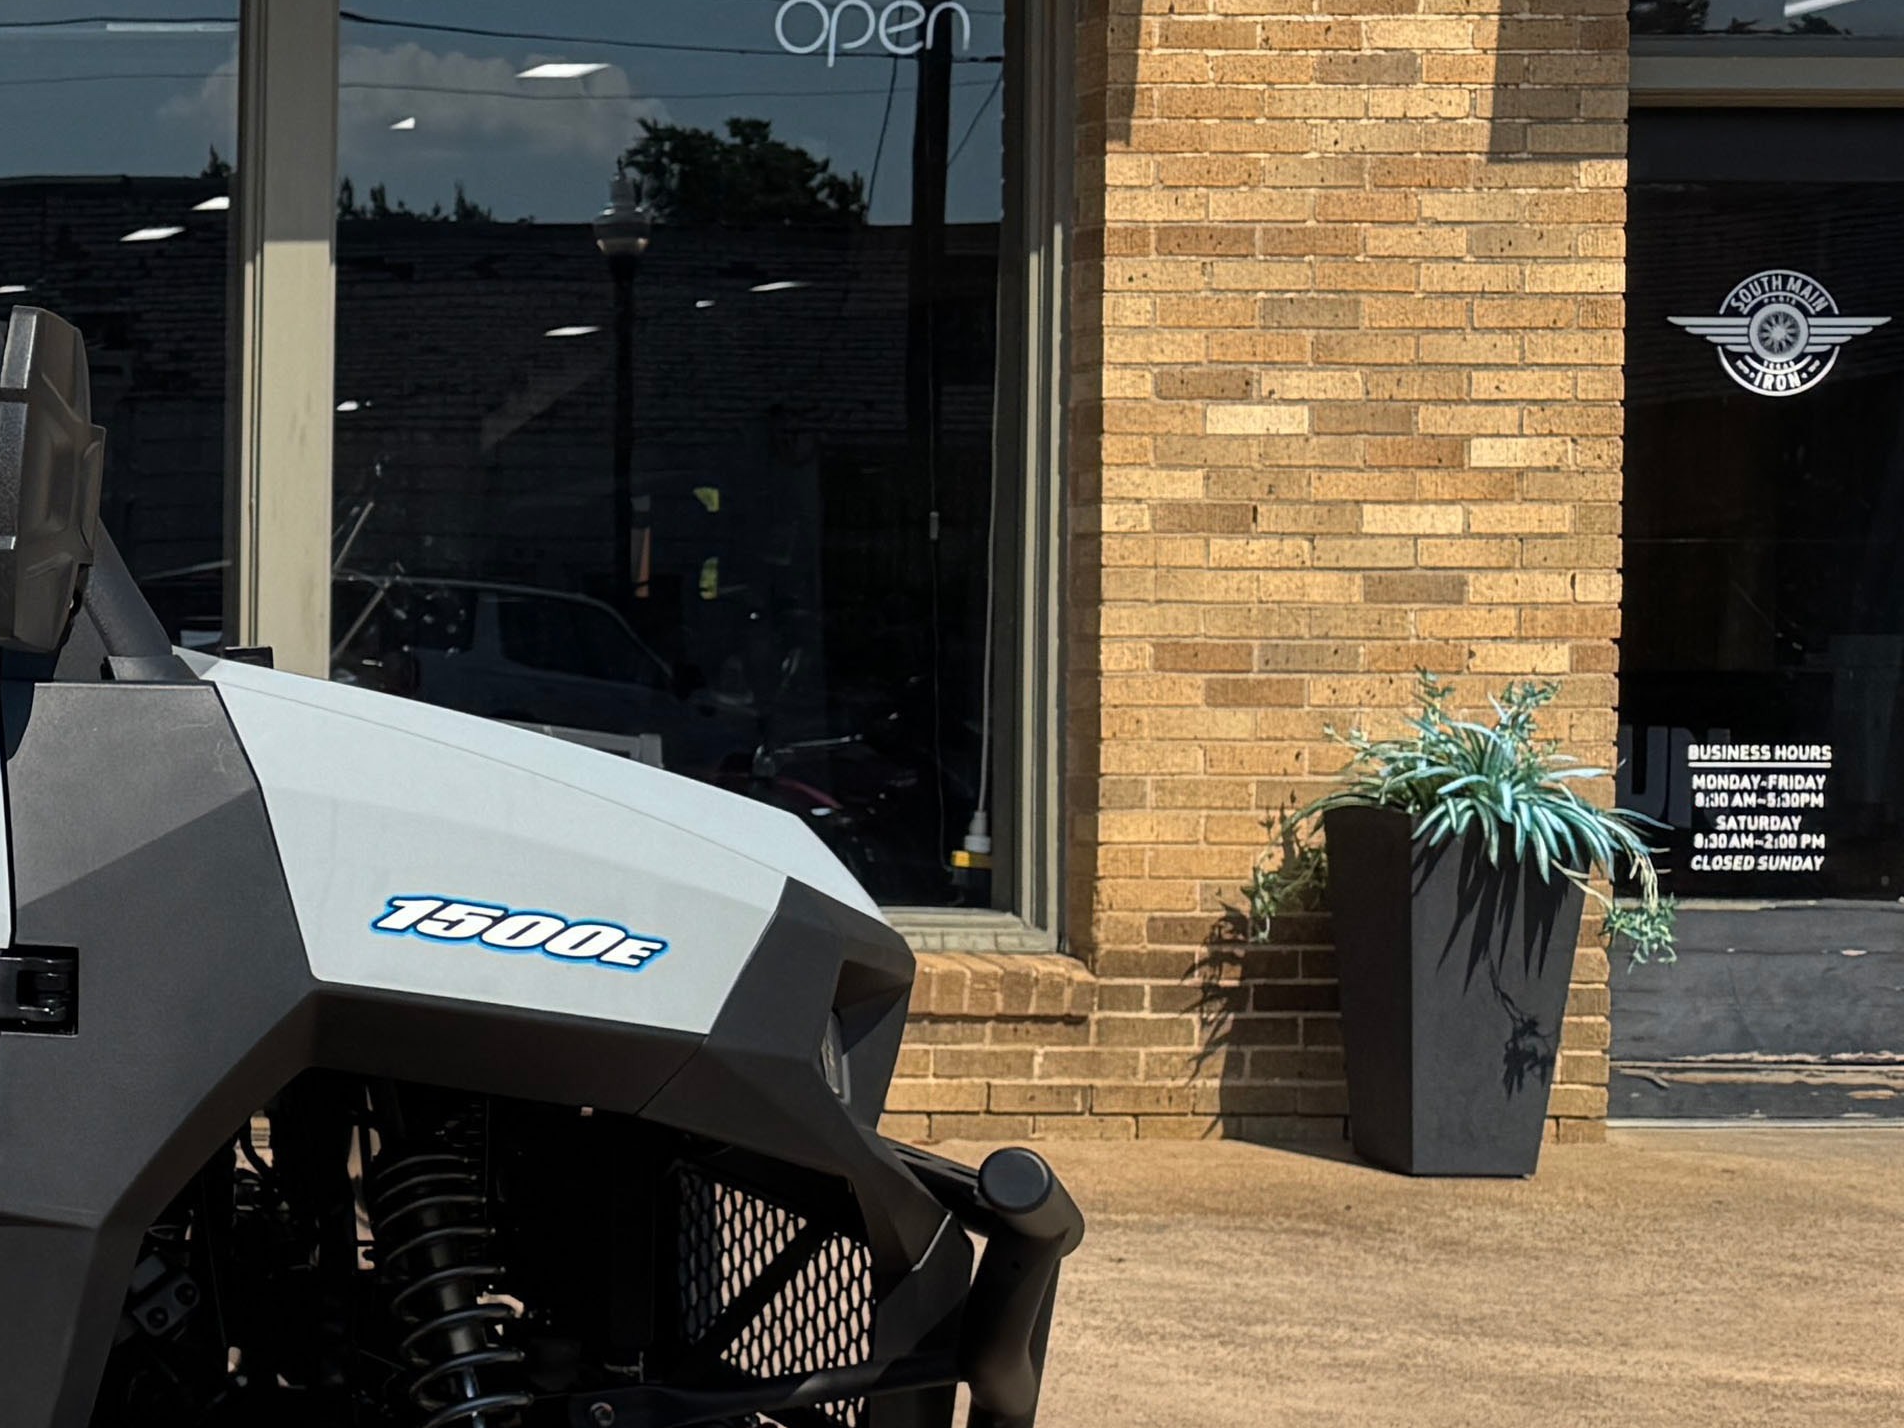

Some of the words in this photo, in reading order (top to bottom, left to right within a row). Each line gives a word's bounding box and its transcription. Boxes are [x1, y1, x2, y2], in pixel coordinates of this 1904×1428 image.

[1730, 275, 1782, 312] SOUTH
[1786, 276, 1829, 312] MAIN
[1753, 371, 1802, 391] IRON
[1687, 744, 1771, 761] BUSINESS
[1774, 744, 1833, 761] HOURS
[1691, 773, 1827, 790] MONDAY-FRIDAY
[1715, 814, 1802, 831] SATURDAY
[1690, 854, 1756, 871] CLOSED
[1756, 855, 1825, 872] SUNDAY
[373, 896, 667, 969] 1500E
